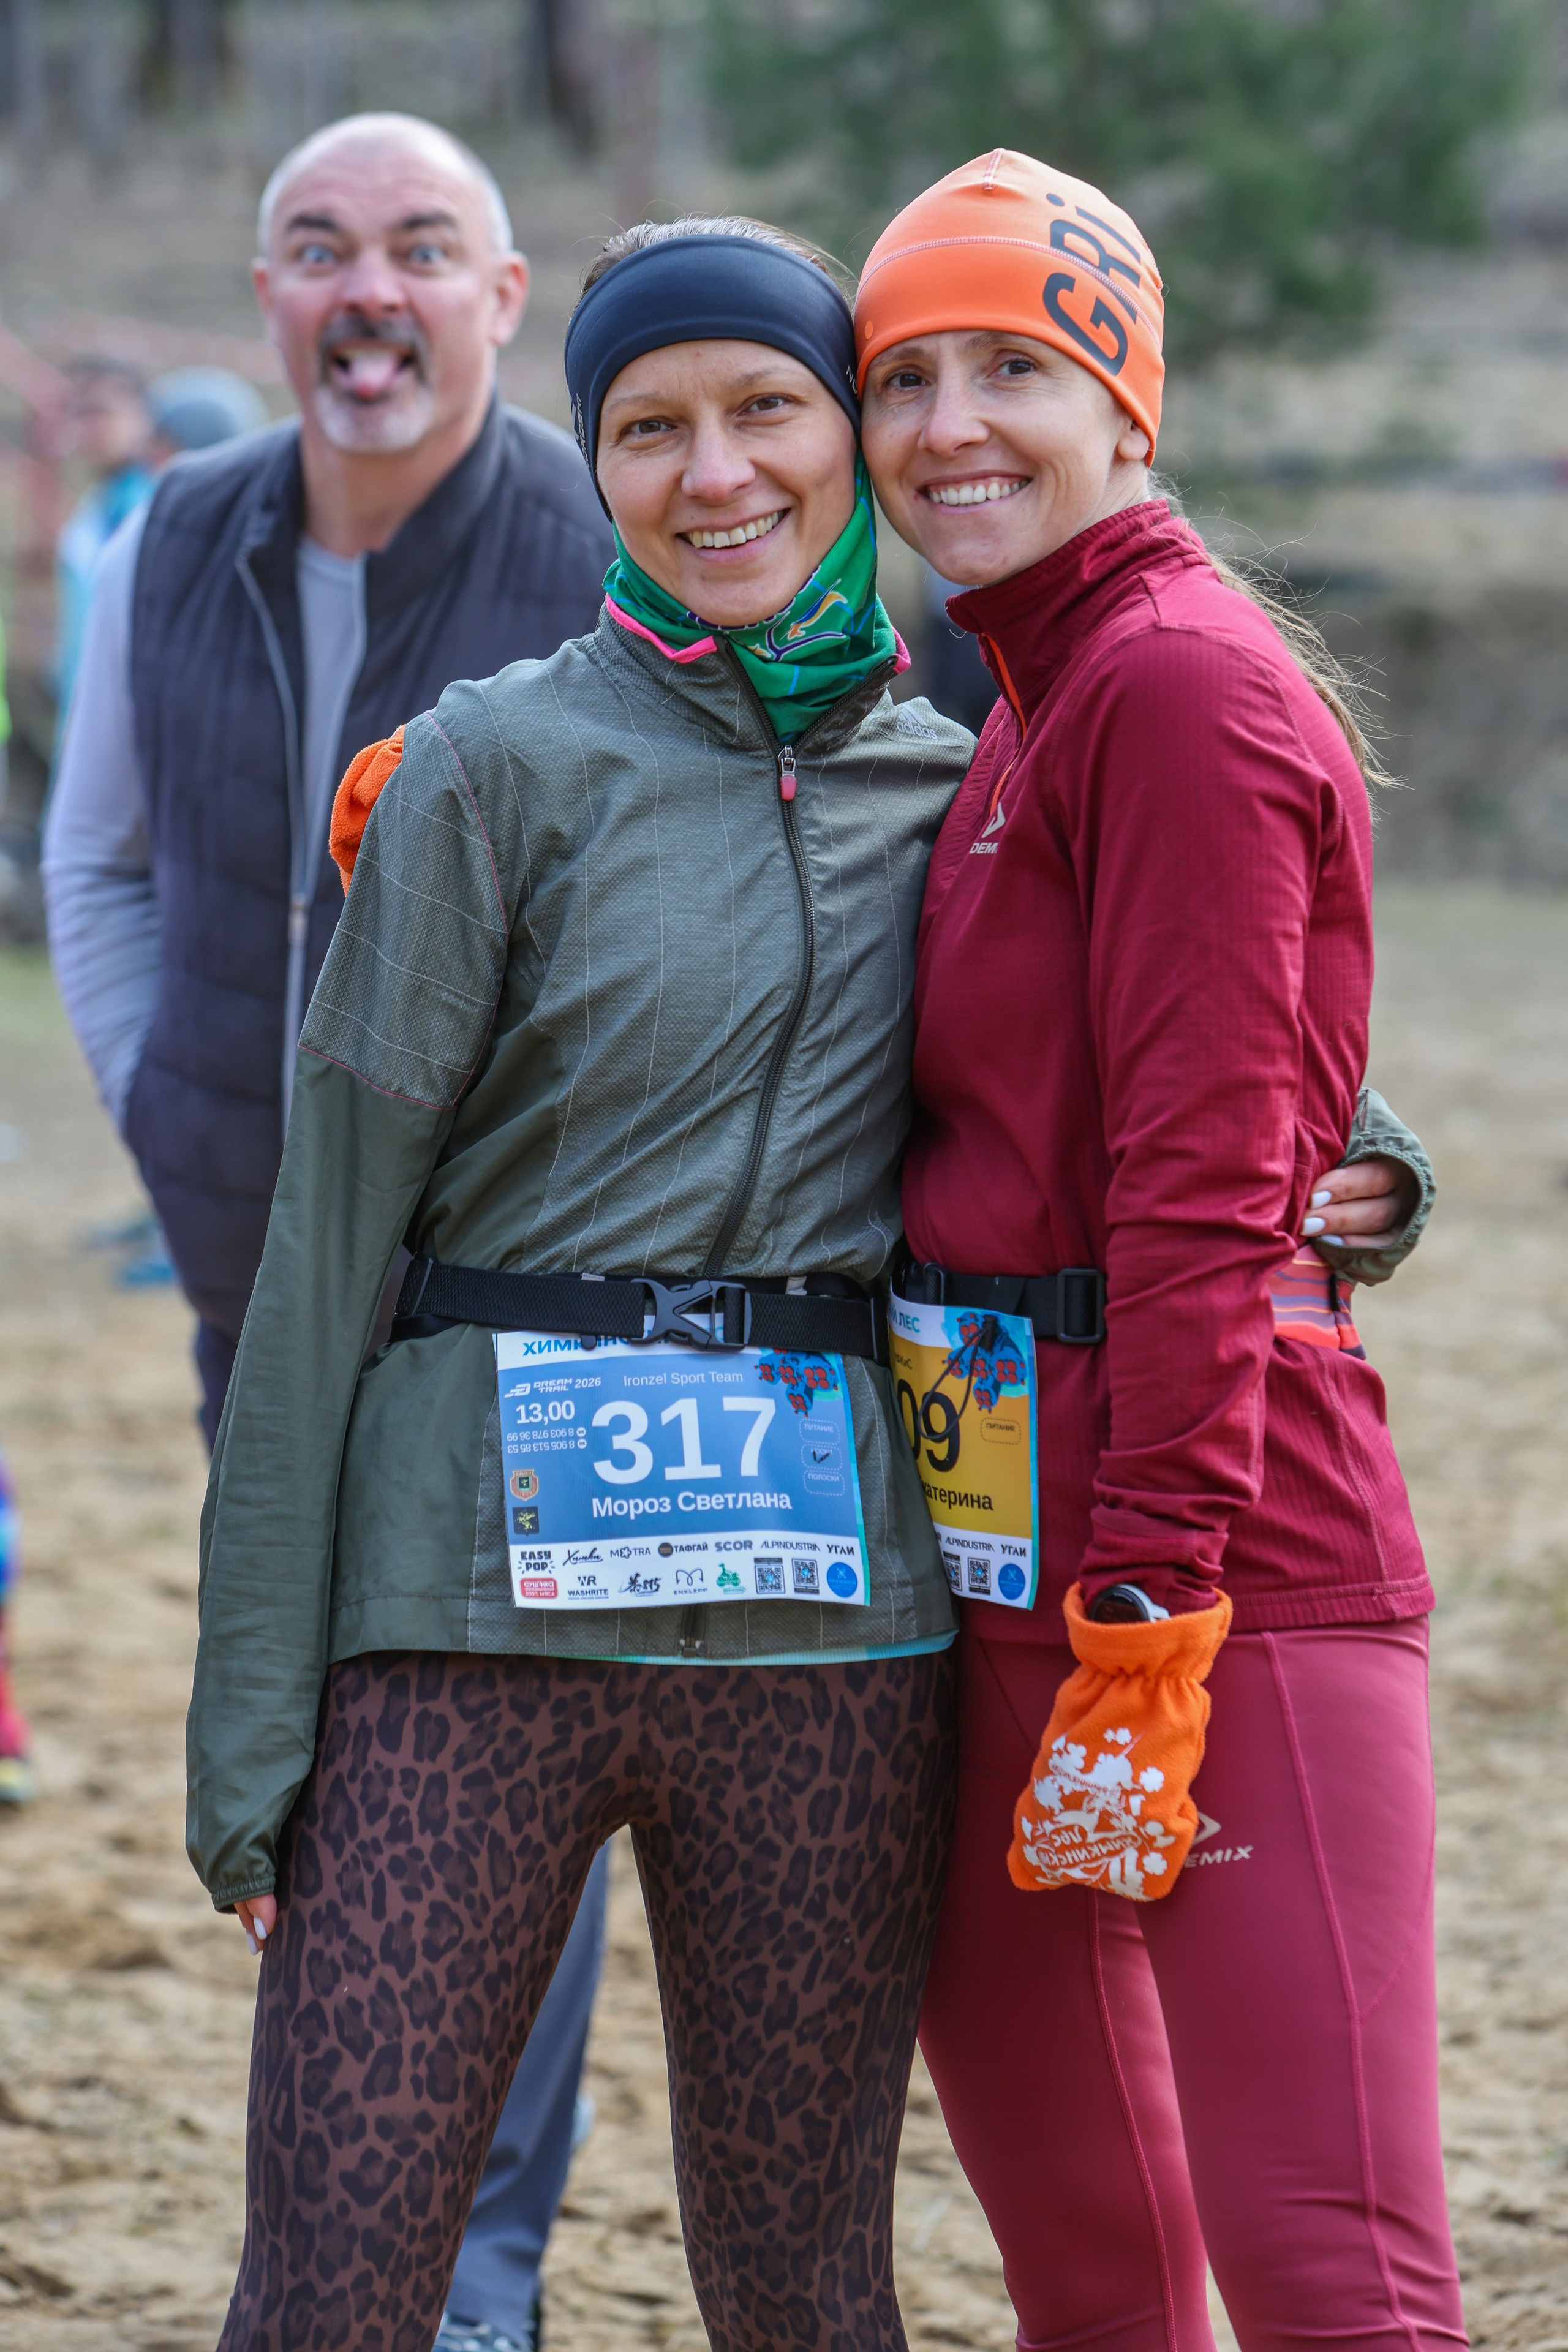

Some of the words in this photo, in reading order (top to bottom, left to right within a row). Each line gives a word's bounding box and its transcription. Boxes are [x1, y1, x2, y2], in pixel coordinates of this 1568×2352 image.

[576, 393, 590, 468] ORDSKI
[897, 721, 938, 739] adidas
[969, 842, 998, 854] DEM
[899, 1311, 921, 1333] ЛЕС
[533, 1378, 573, 1389] DREAM
[575, 1377, 601, 1389] 2026
[624, 1374, 667, 1387] Ironzel
[671, 1373, 705, 1387] Sport
[709, 1371, 743, 1383] Team
[538, 1385, 569, 1394] TRAIL
[516, 1400, 575, 1426] 13,00
[551, 1428, 567, 1438] 903
[568, 1428, 575, 1436] 8
[804, 1423, 834, 1433] ПИТАНИЕ
[507, 1433, 518, 1442] 99
[519, 1431, 531, 1441] 36
[532, 1430, 549, 1440] 978
[592, 1396, 776, 1485] 317
[507, 1445, 519, 1454] 53
[521, 1444, 531, 1453] 85
[533, 1442, 549, 1452] 513
[552, 1441, 567, 1450] 905
[569, 1440, 575, 1449] 8
[921, 1476, 994, 1511] катерина
[592, 1496, 672, 1520] Мороз
[677, 1491, 793, 1511] Светлана
[674, 1542, 709, 1553] ТАФГАЙ
[715, 1540, 753, 1553] SCOR
[761, 1540, 821, 1552] ALPINDUSTRIA
[946, 1536, 995, 1553] ALPINDUSTRIA
[521, 1550, 551, 1561] EASY
[526, 1562, 548, 1572] POP
